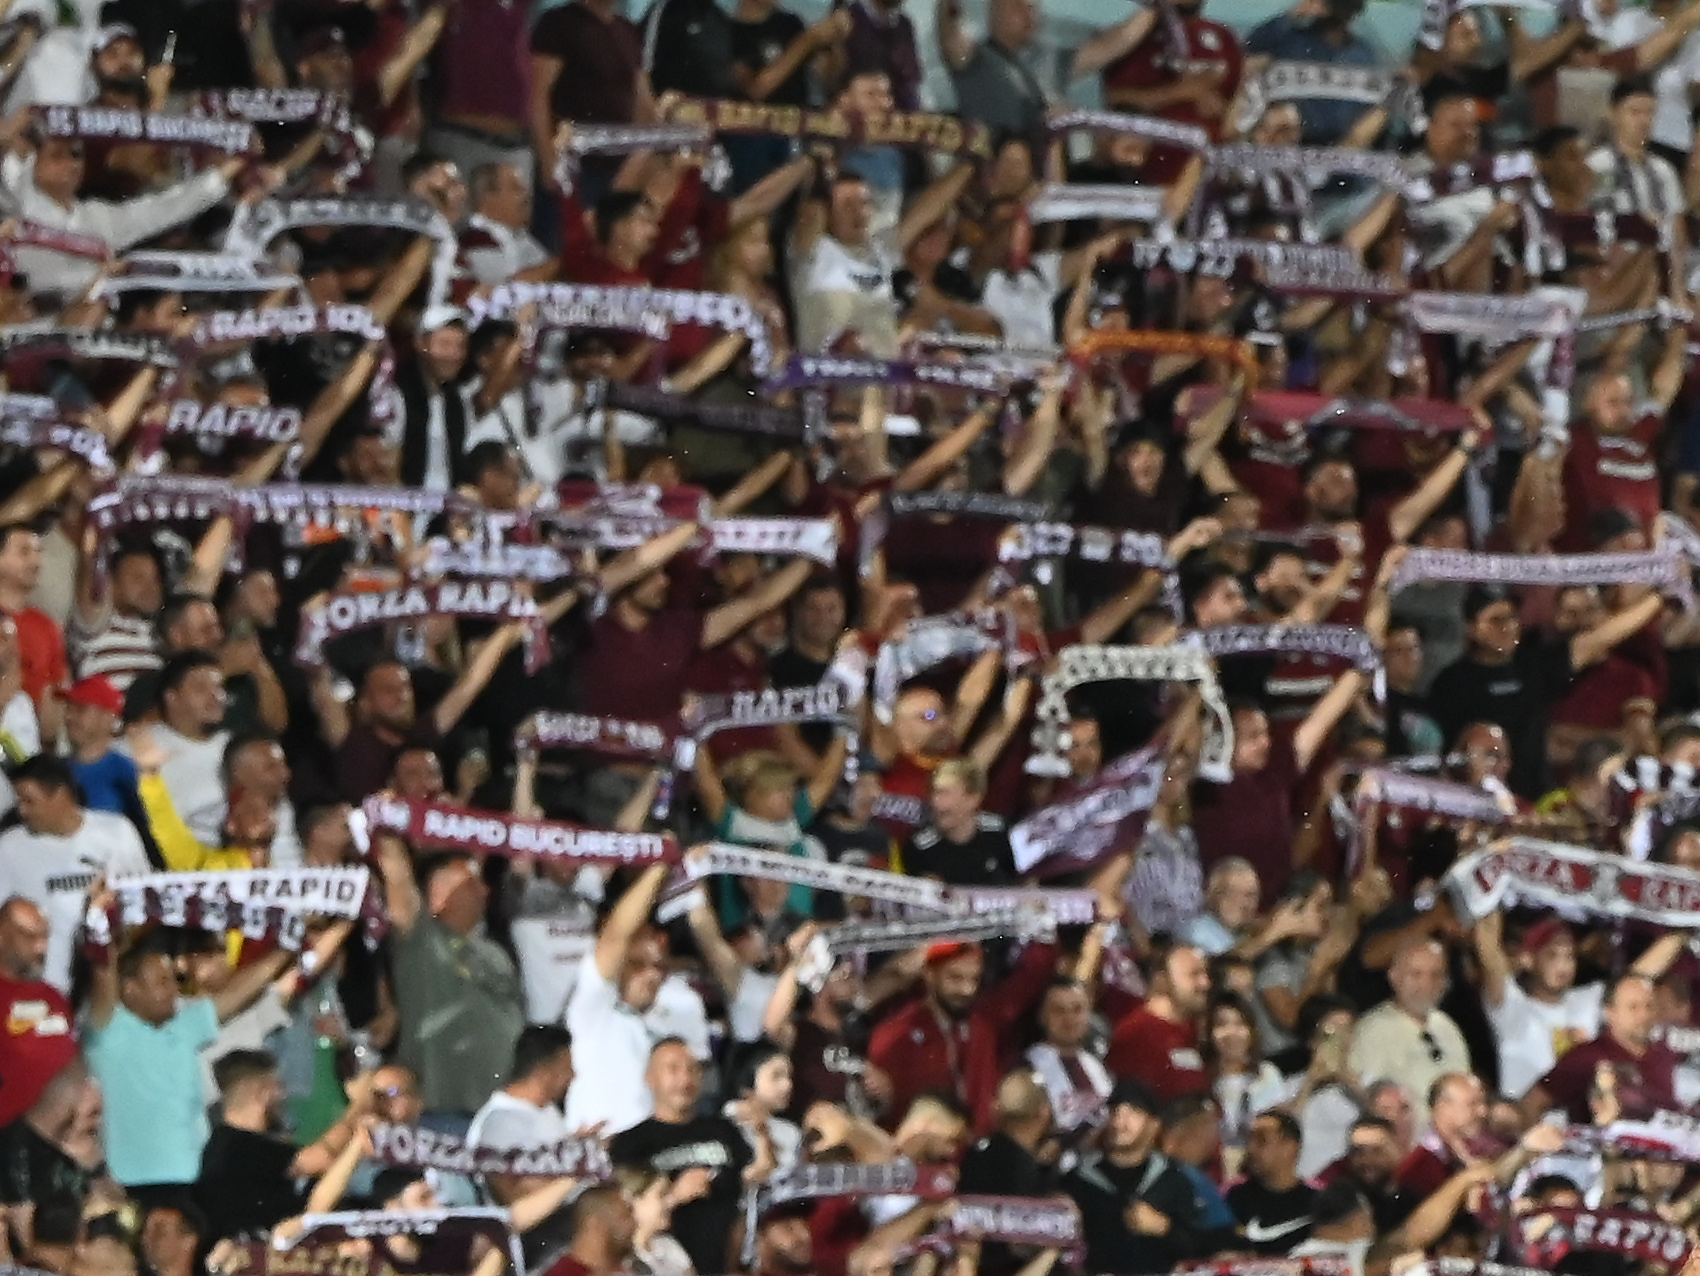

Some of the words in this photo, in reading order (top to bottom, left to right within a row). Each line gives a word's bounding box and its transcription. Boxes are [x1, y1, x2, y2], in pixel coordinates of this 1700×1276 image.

[166, 402, 300, 442] RAPID
[423, 811, 508, 846] RAPID
[250, 879, 357, 903] RAPID
